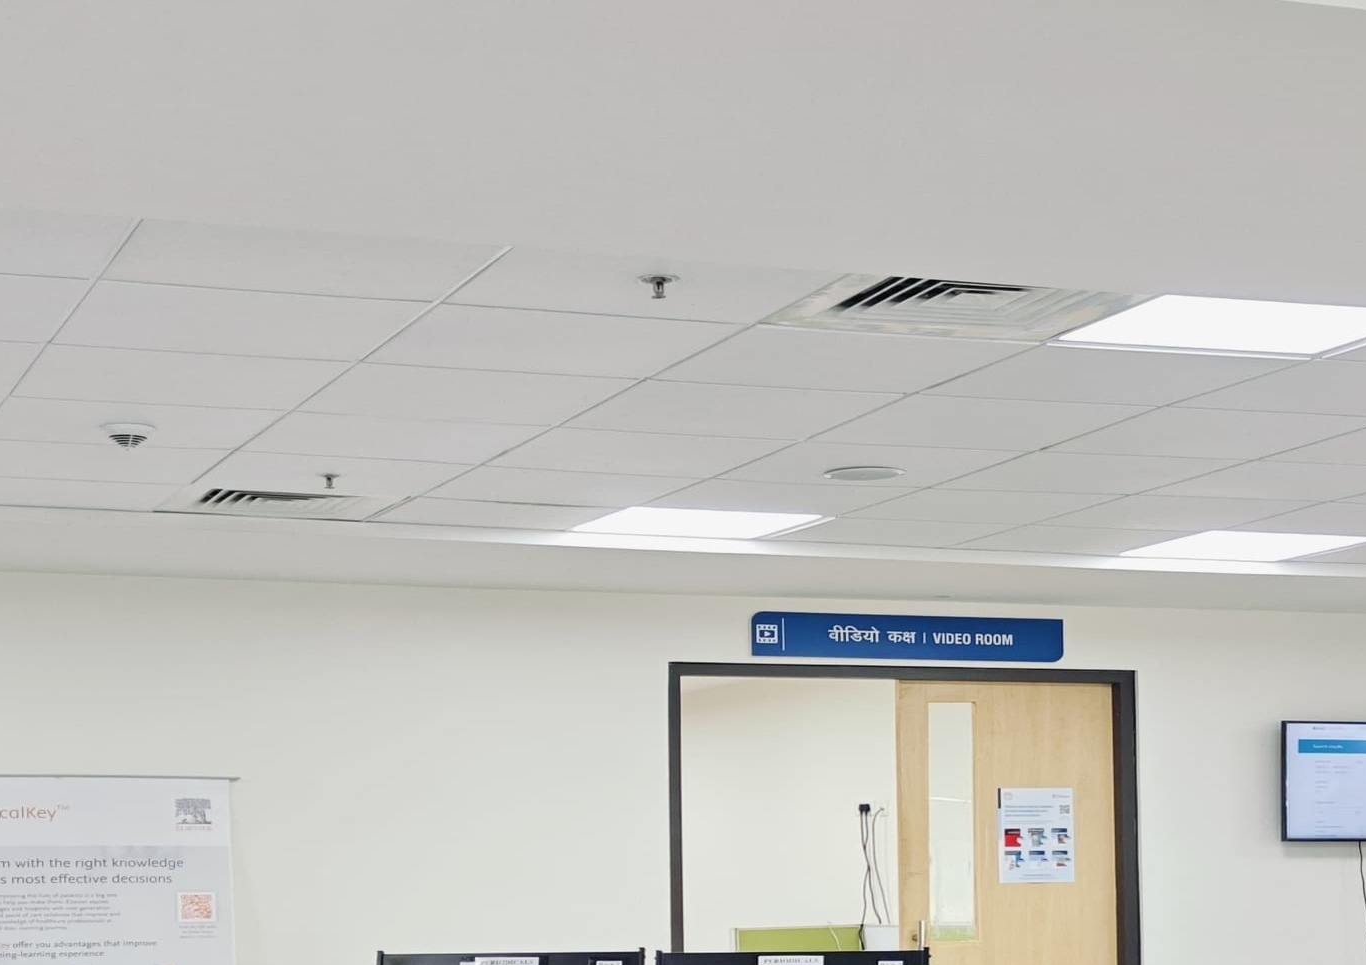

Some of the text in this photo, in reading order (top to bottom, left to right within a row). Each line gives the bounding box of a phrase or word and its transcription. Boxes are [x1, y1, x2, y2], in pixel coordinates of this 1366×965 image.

[828, 624, 916, 645] वीडियो कक्ष
[932, 631, 1014, 647] VIDEO ROOM
[15, 858, 45, 869] with
[49, 858, 71, 868] the
[75, 858, 107, 870] right
[111, 857, 184, 870] knowledge
[11, 875, 46, 885] most
[50, 873, 108, 885] effective
[111, 873, 173, 884] decisions
[12, 941, 33, 949] offer
[35, 942, 51, 950] you
[53, 940, 102, 950] advantages
[103, 940, 120, 948] that
[58, 950, 105, 960] experience
